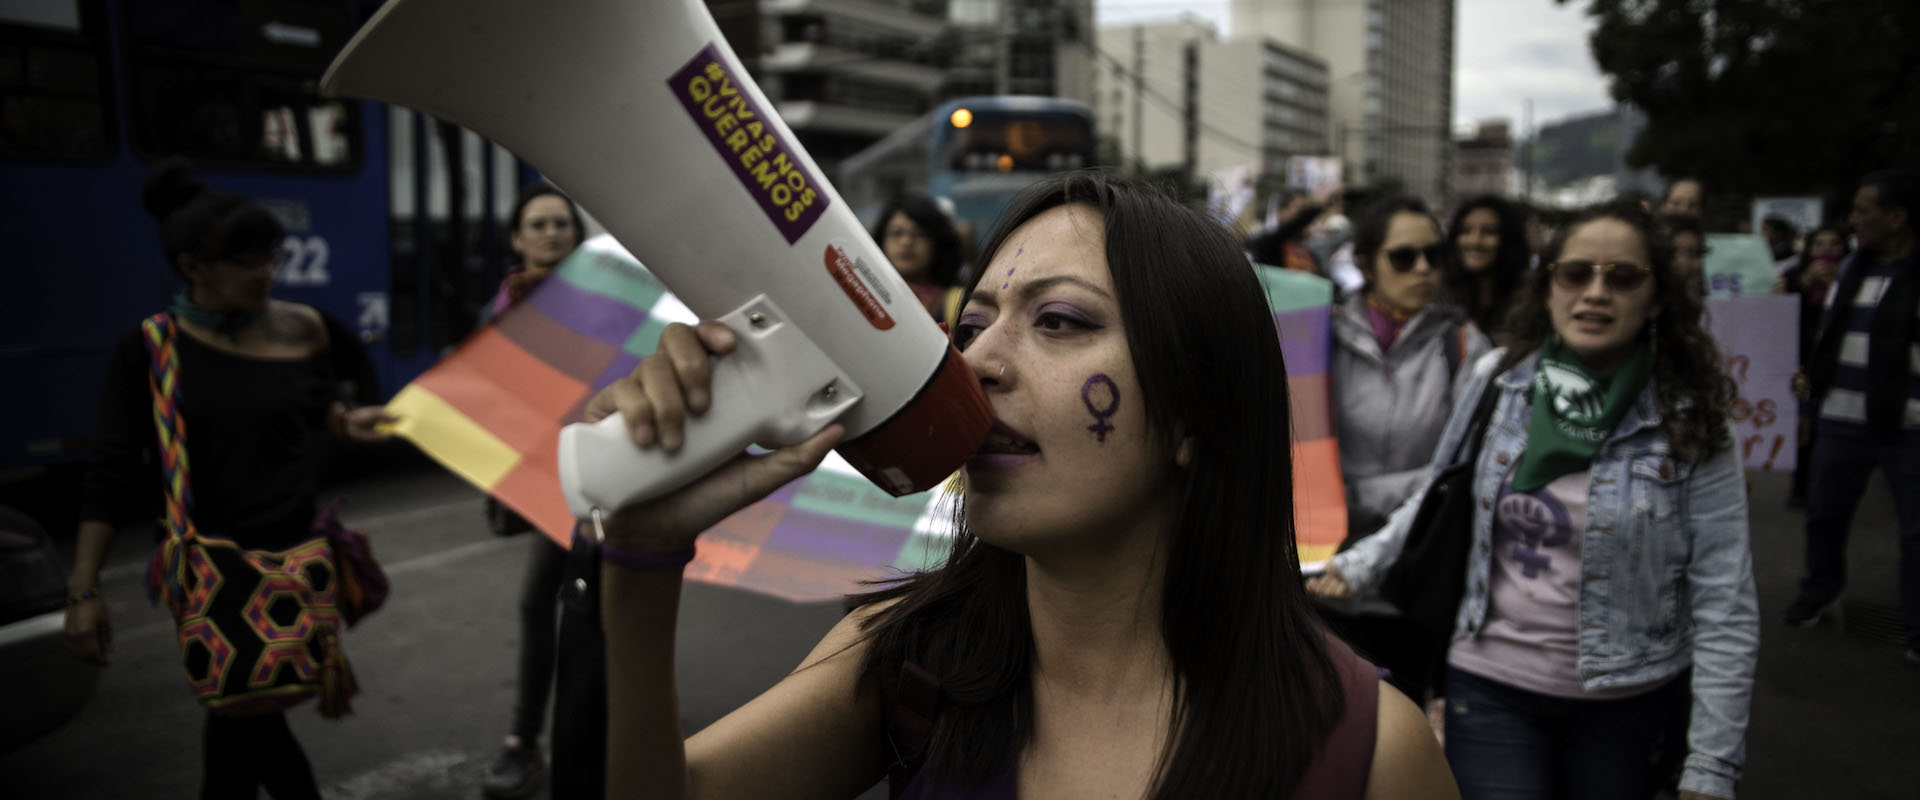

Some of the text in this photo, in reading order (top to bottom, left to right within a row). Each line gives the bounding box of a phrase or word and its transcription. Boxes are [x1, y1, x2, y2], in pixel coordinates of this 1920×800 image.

[688, 75, 804, 222] QUEREMOS
[704, 61, 817, 207] #VIVAS NOS
[277, 234, 331, 286] 22
